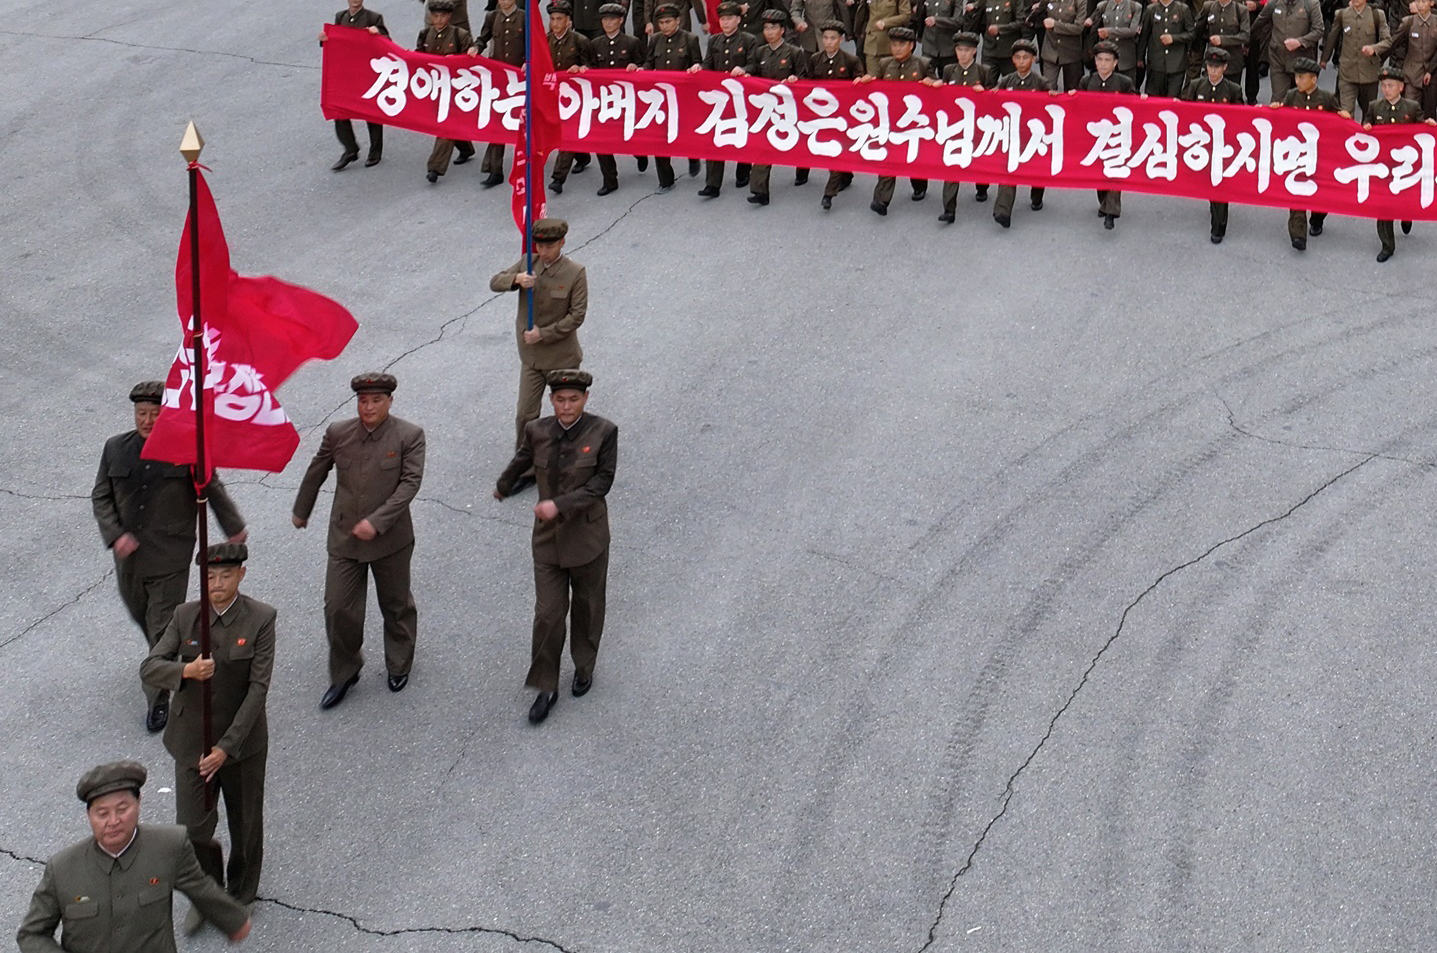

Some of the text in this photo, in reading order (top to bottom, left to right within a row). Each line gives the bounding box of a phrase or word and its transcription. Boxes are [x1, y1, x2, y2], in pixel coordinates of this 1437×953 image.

[362, 50, 526, 131] 경애하는
[559, 77, 679, 144] 아버지
[694, 78, 1066, 176] 김정은원수님께서
[1080, 106, 1320, 196] 결심하시면
